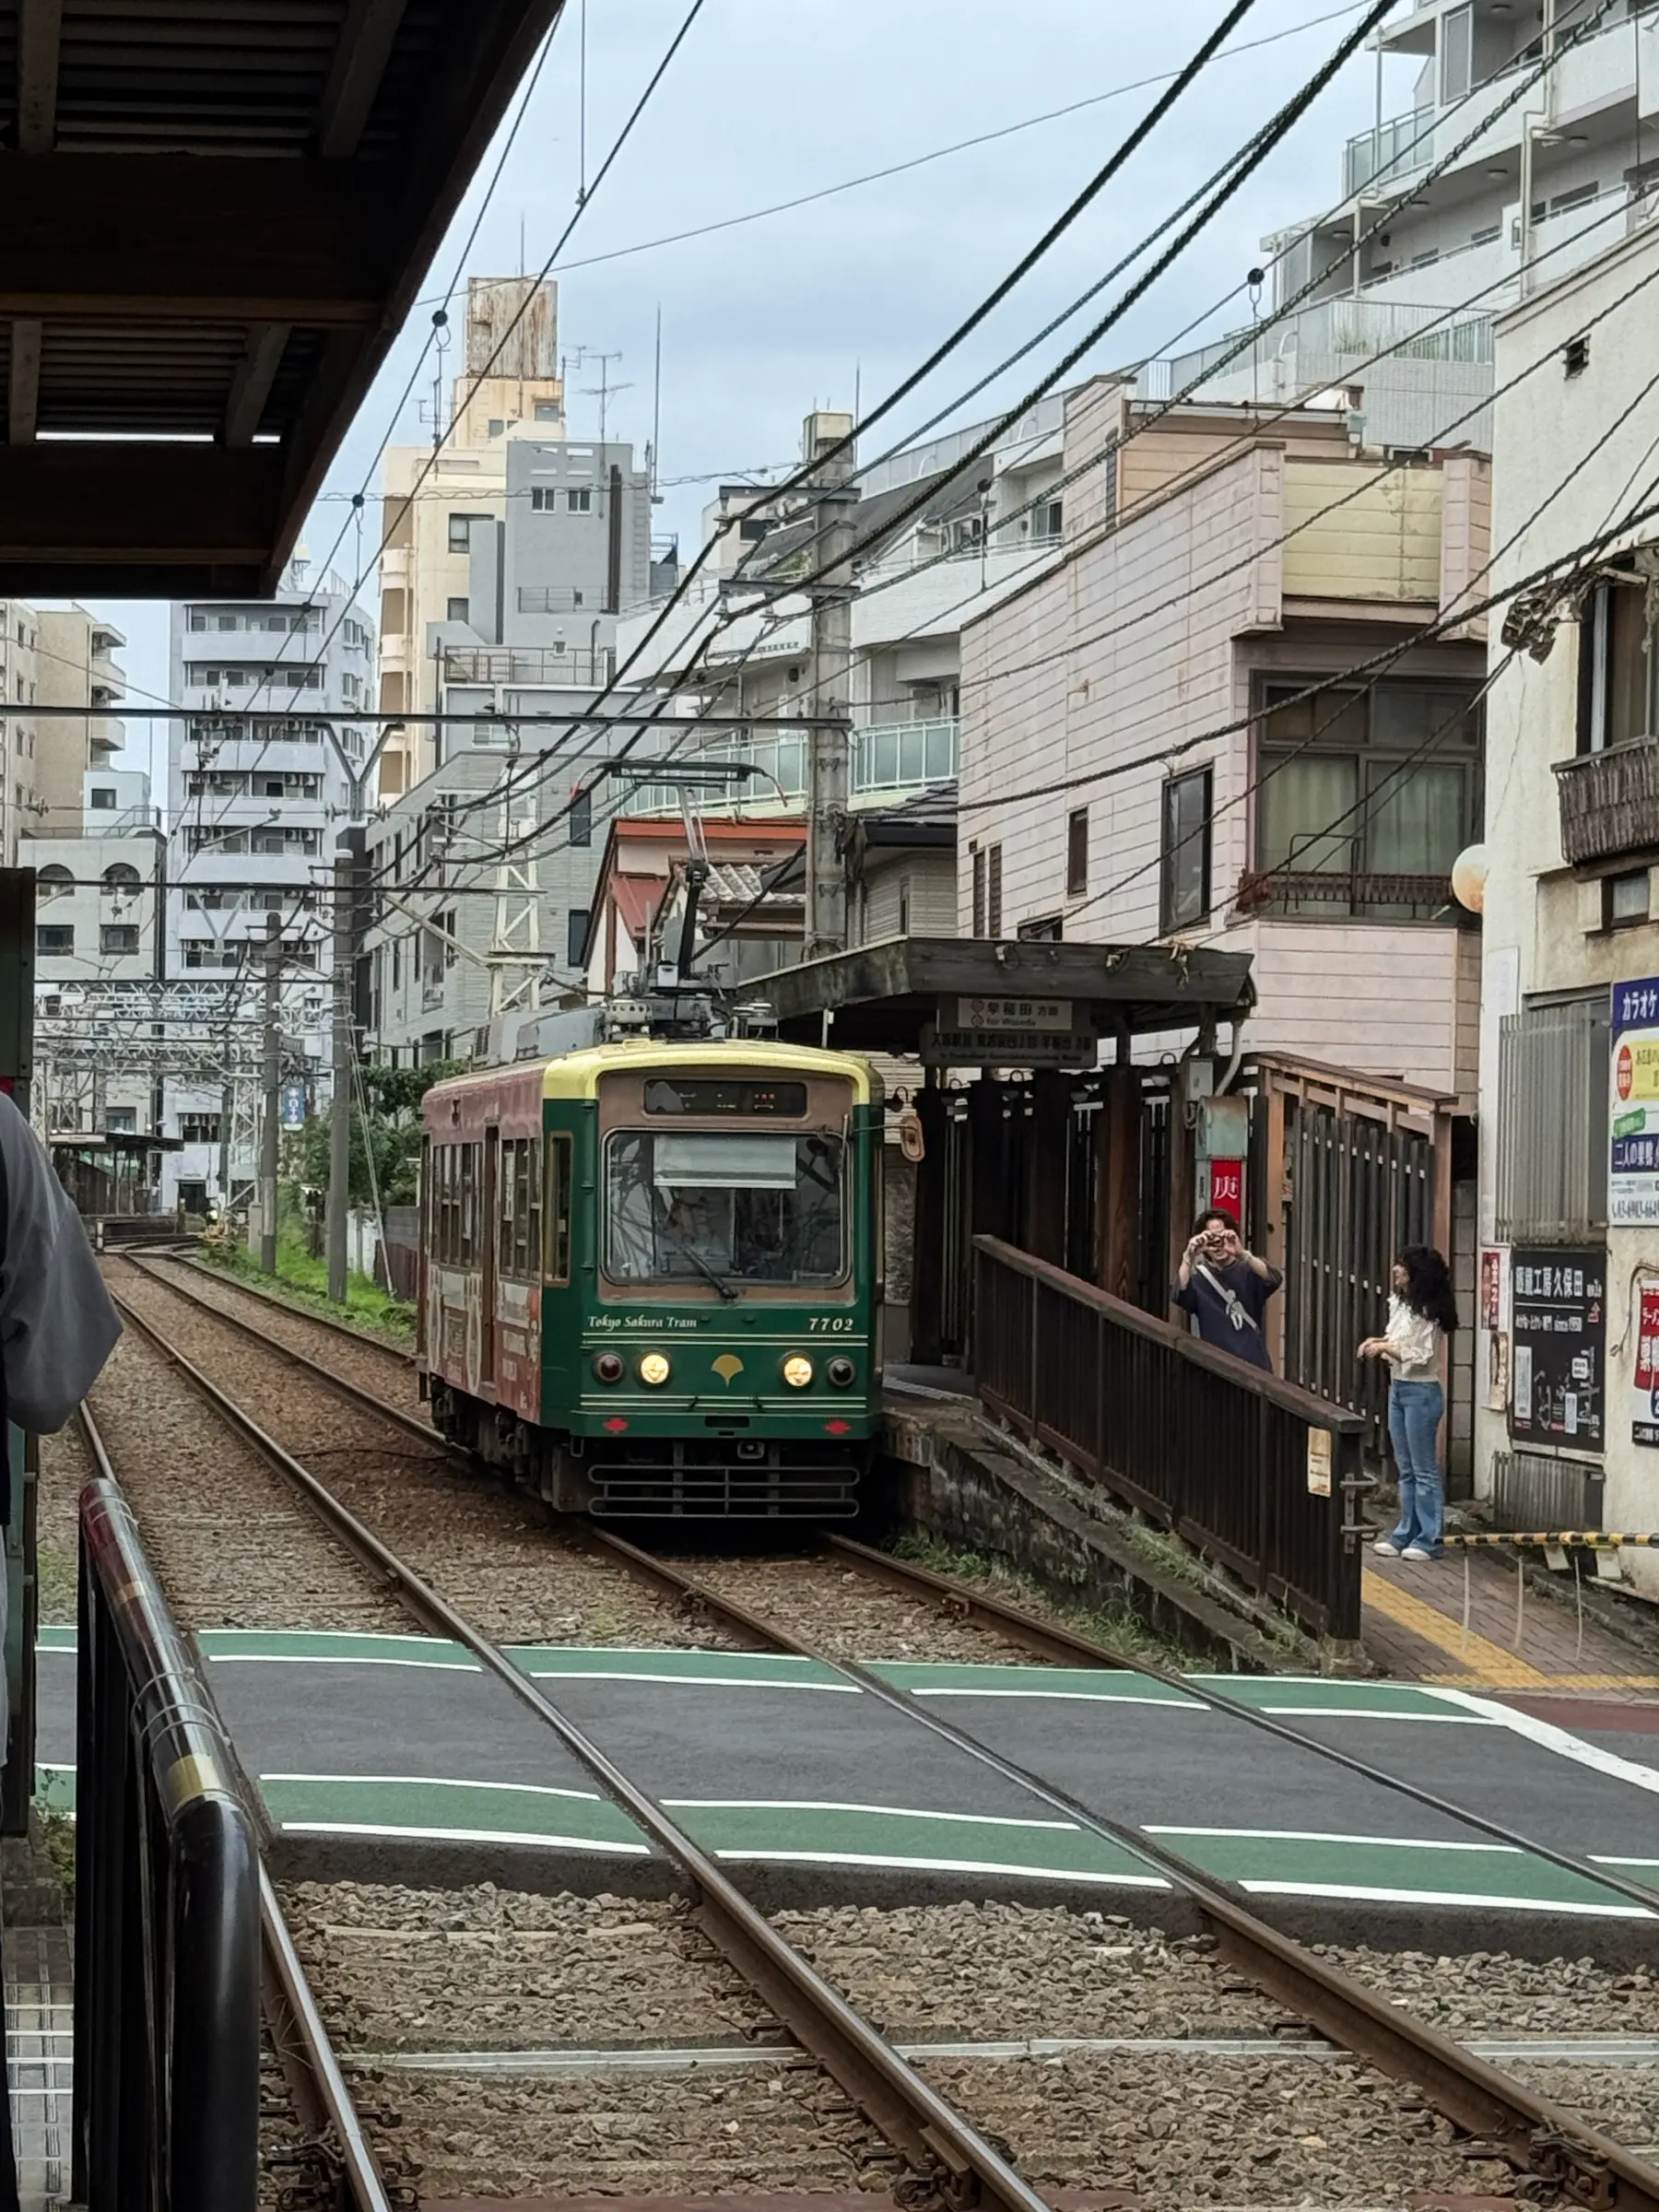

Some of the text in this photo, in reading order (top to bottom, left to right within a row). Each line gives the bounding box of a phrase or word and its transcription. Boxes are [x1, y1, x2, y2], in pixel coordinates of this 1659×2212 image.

[987, 1001, 1032, 1017] 早稲田
[1622, 988, 1658, 1021] カラオケ
[1615, 1139, 1659, 1169] 二人の巣鴨
[587, 1313, 698, 1332] Tokyo Sakura Tram
[808, 1317, 854, 1332] 7702
